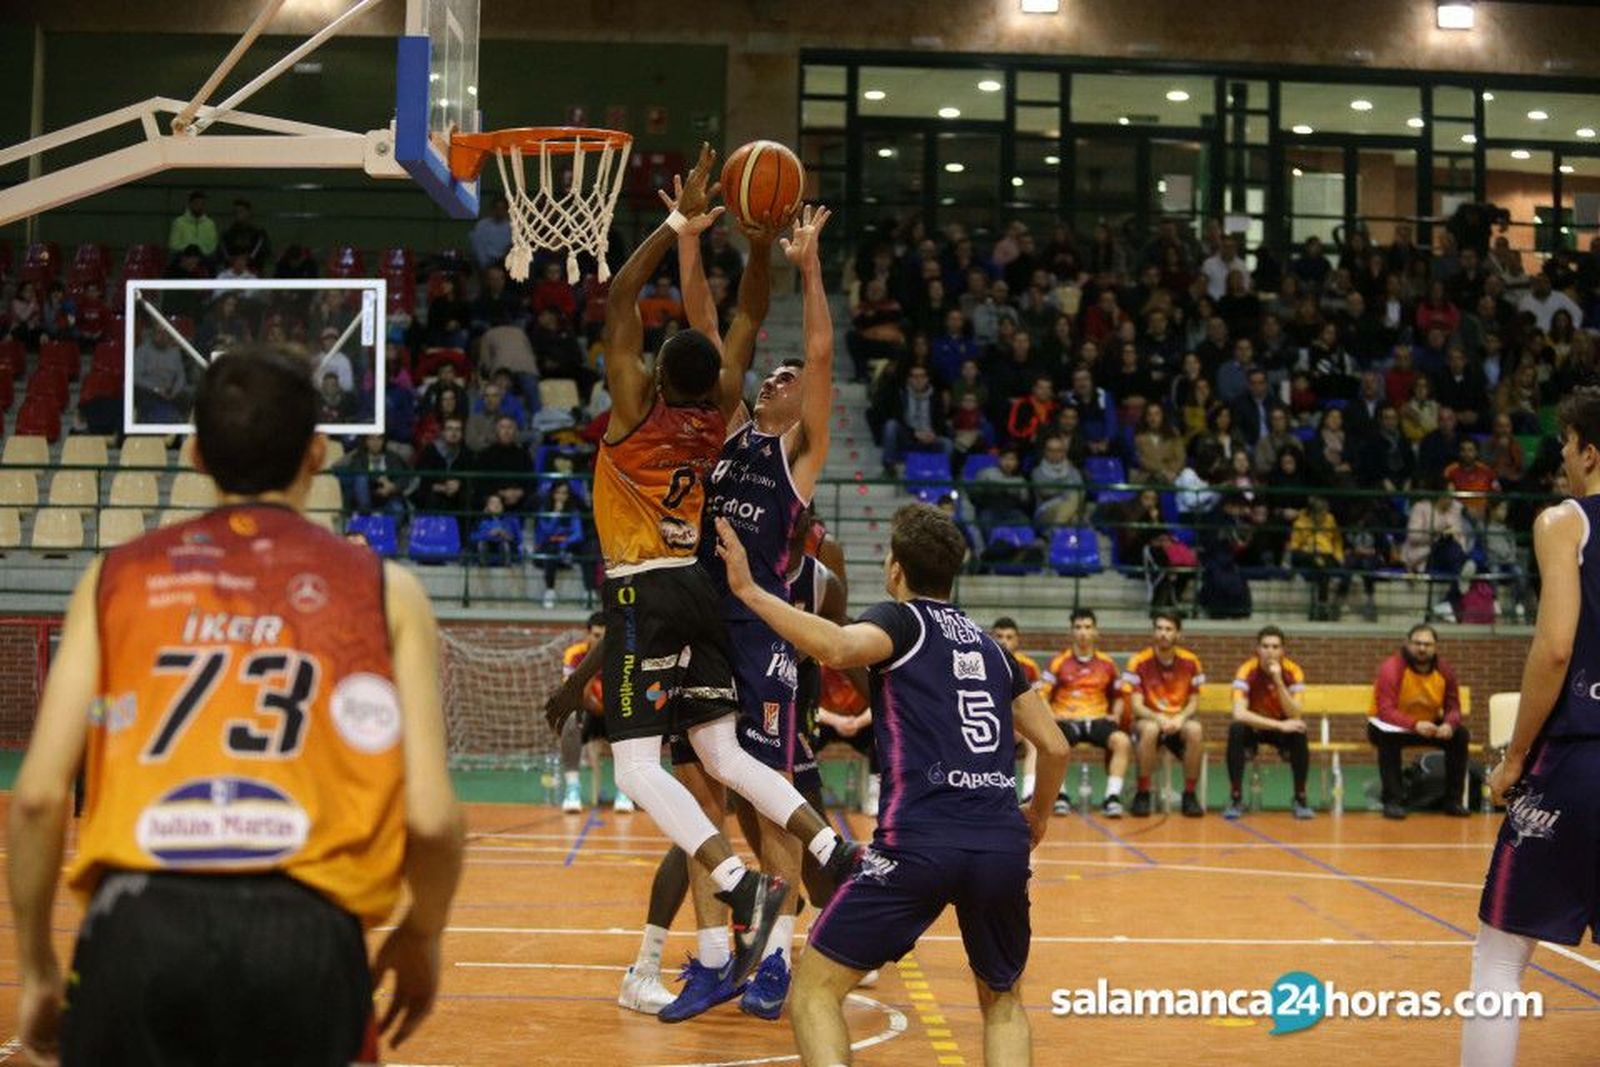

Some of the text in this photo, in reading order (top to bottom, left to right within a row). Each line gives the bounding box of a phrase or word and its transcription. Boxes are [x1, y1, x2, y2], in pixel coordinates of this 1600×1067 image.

[661, 466, 697, 510] 0
[138, 646, 323, 765] 73
[956, 688, 1001, 753] 5
